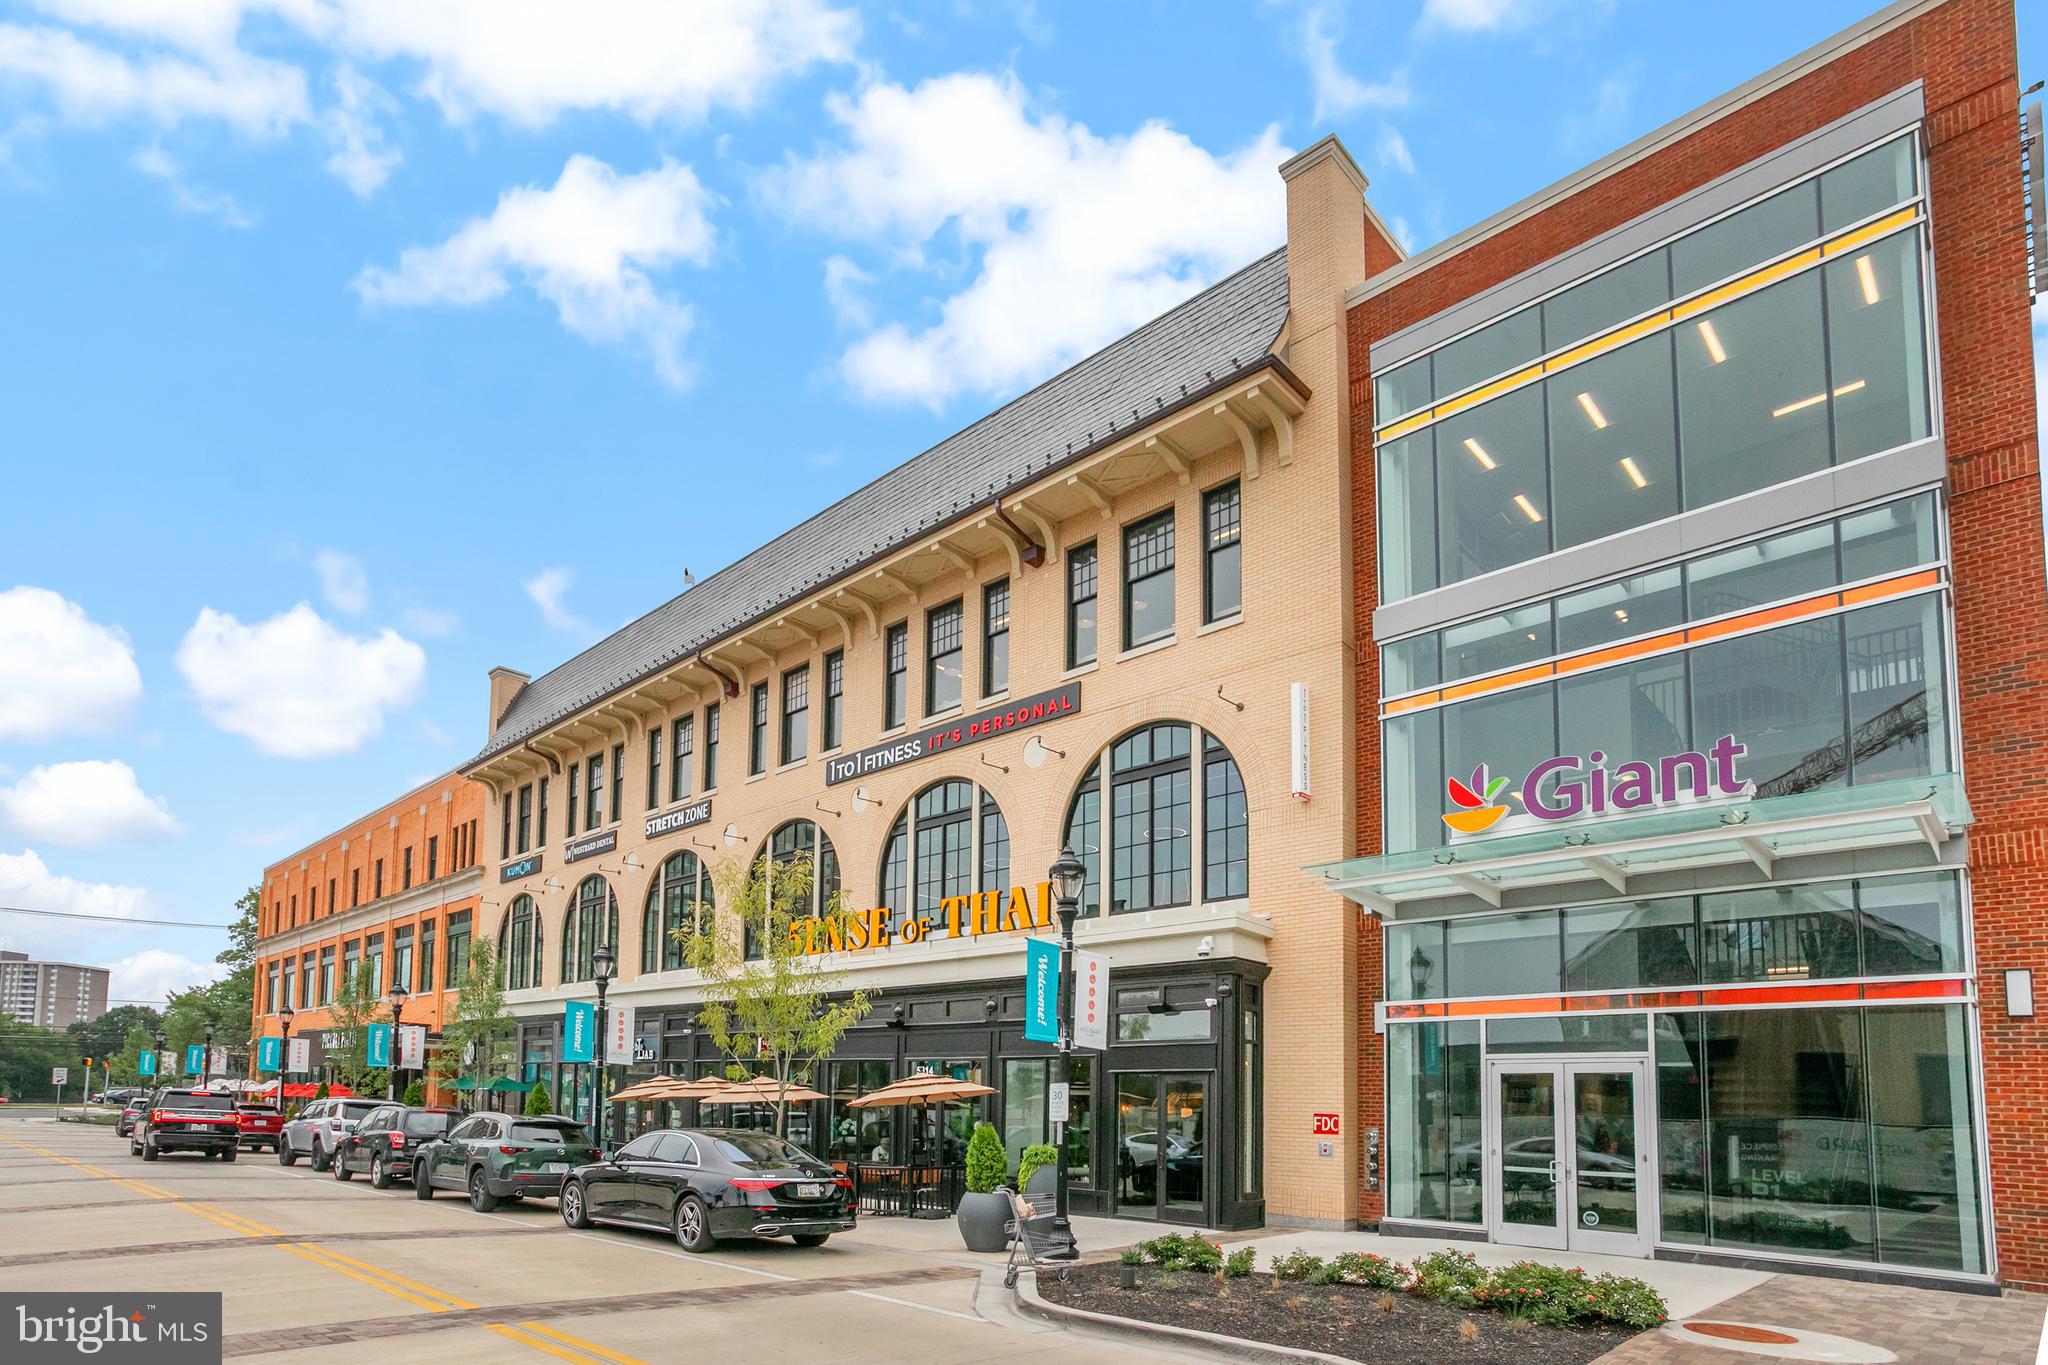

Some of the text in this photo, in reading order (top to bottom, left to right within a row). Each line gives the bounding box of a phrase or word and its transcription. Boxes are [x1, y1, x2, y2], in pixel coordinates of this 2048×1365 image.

[864, 739, 922, 771] FITNESS
[928, 730, 961, 750] IT'S
[970, 695, 1073, 737] PERSONAL
[1521, 733, 1754, 821] Giant
[645, 803, 709, 835] STRETCH ZONE
[574, 841, 597, 856] WESTBARD
[597, 836, 615, 849] DENTAL
[506, 861, 532, 877] KUMON
[900, 917, 933, 943] OF
[940, 881, 1053, 938] THAI
[1037, 953, 1048, 1027] Welcome!
[374, 1029, 383, 1062] Welcome!
[574, 1009, 584, 1053] Welcome!
[1052, 1090, 1063, 1100] 30
[1313, 1116, 1339, 1132] FDC
[1751, 1169, 1806, 1184] LEVEL
